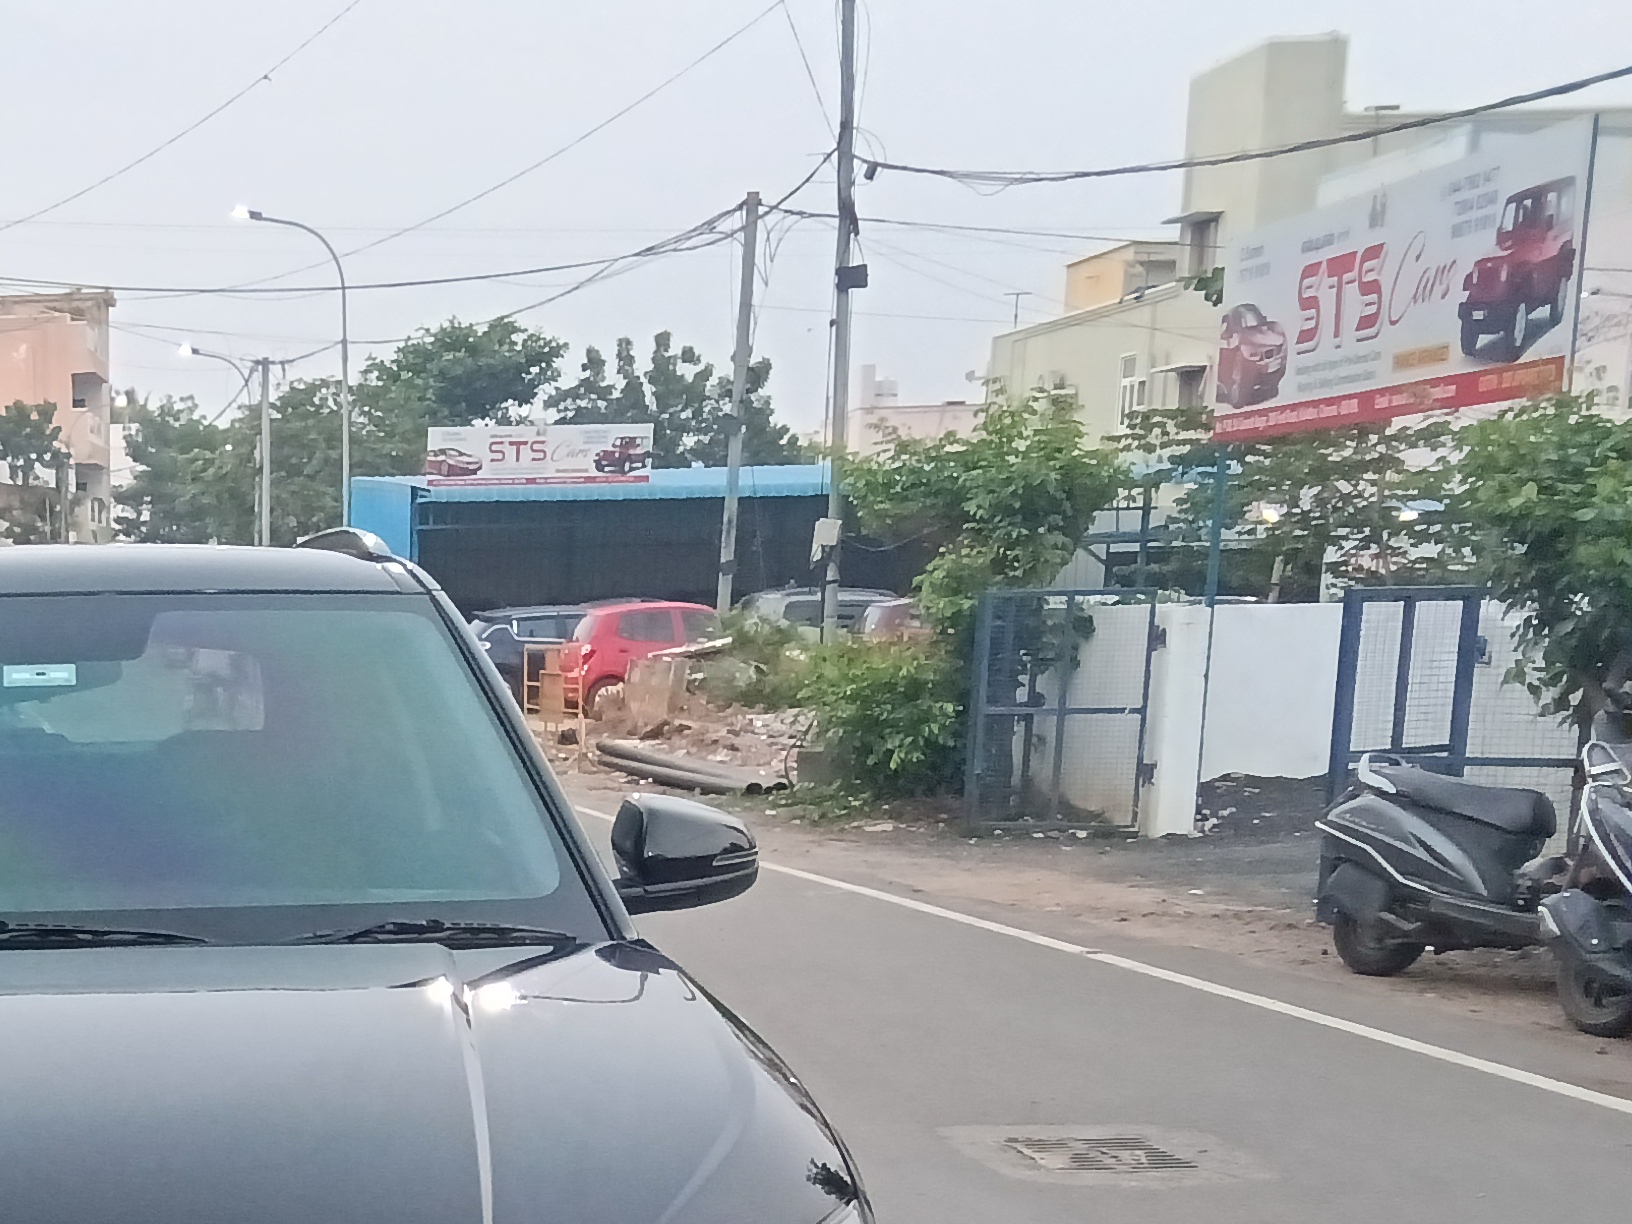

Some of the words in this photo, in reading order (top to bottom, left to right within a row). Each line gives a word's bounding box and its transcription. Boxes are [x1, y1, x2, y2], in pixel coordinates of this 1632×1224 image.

[1297, 242, 1389, 356] STS
[1389, 230, 1458, 327] Cars
[488, 441, 547, 463] STS
[551, 440, 589, 460] Cars
